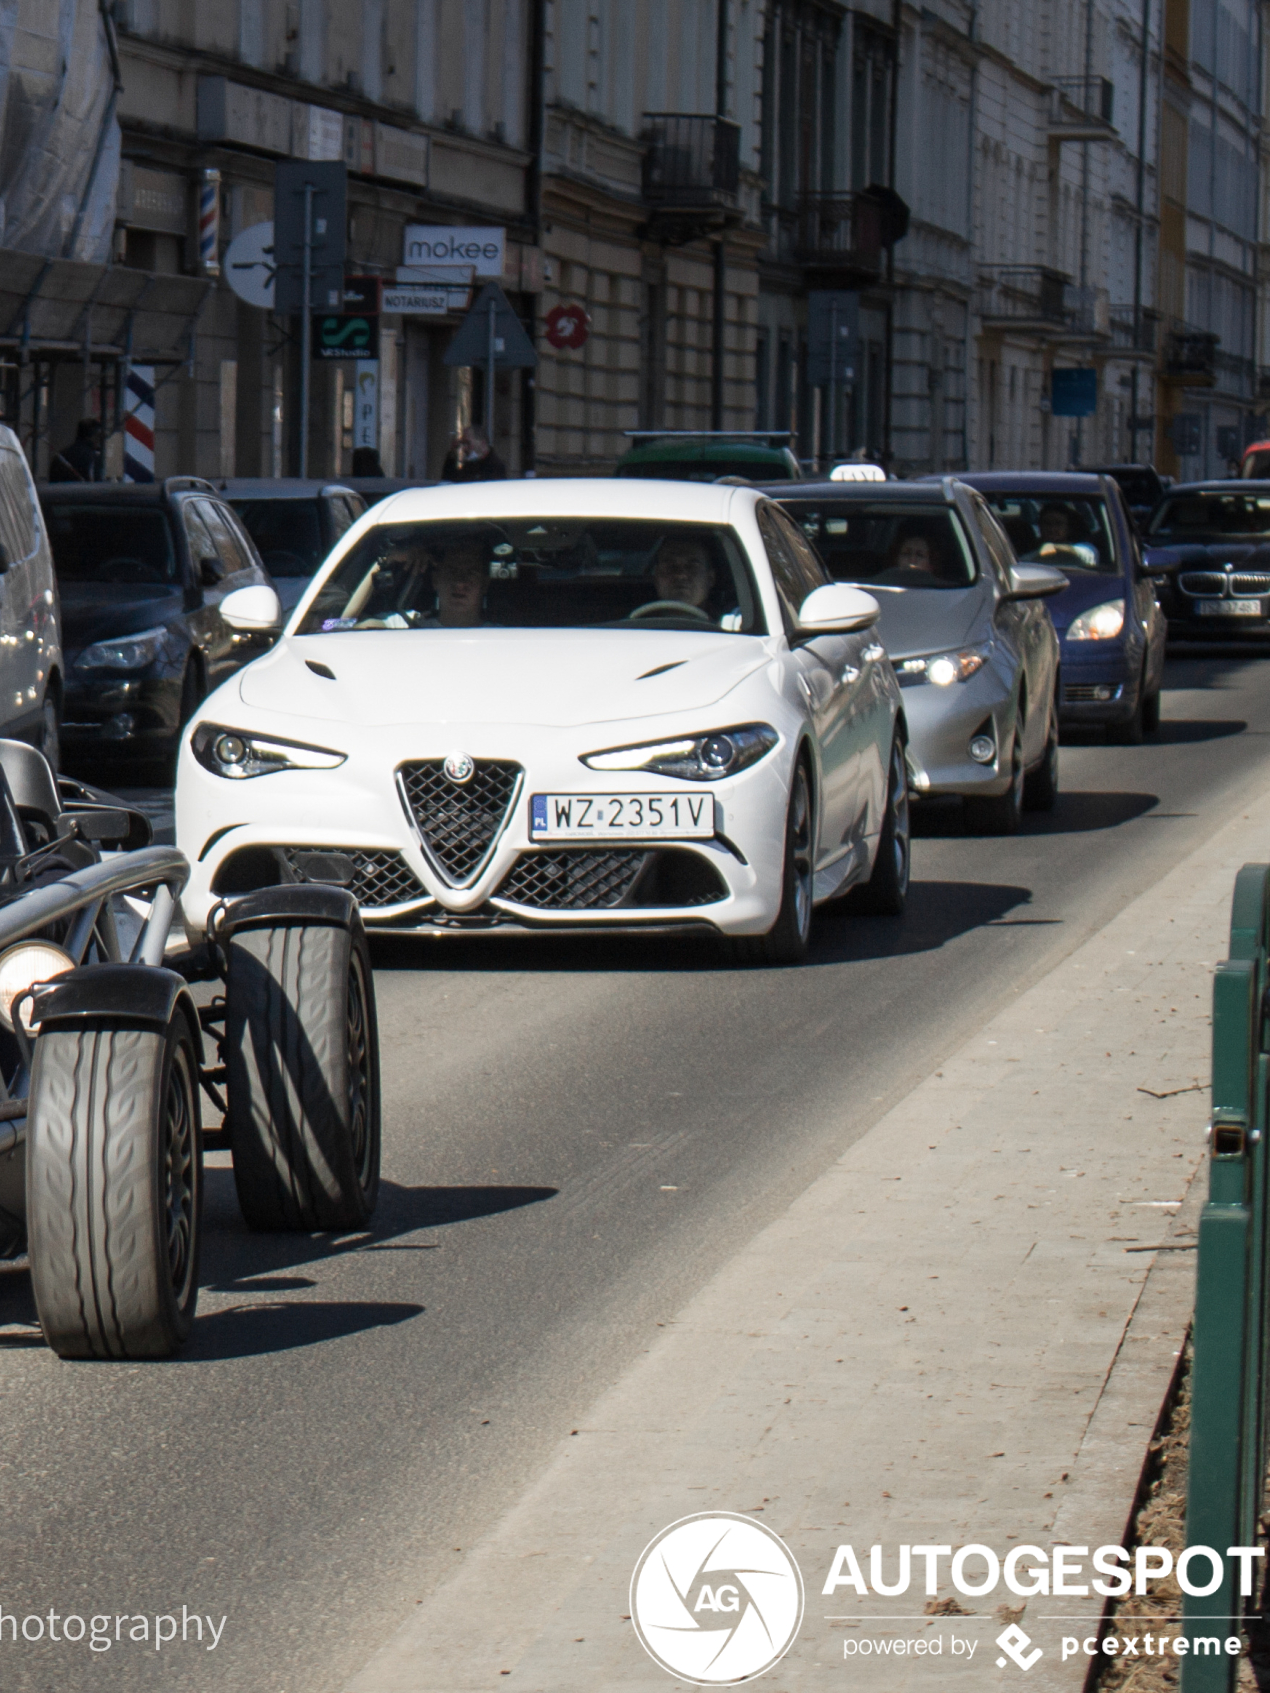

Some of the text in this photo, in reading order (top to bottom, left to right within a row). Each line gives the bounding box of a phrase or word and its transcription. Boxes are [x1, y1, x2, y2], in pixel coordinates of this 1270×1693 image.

[409, 235, 499, 259] mokee
[385, 296, 445, 308] NOTARIUSZ
[838, 470, 876, 481] TAXI
[555, 797, 704, 827] WZ 2351V
[534, 818, 546, 827] PL
